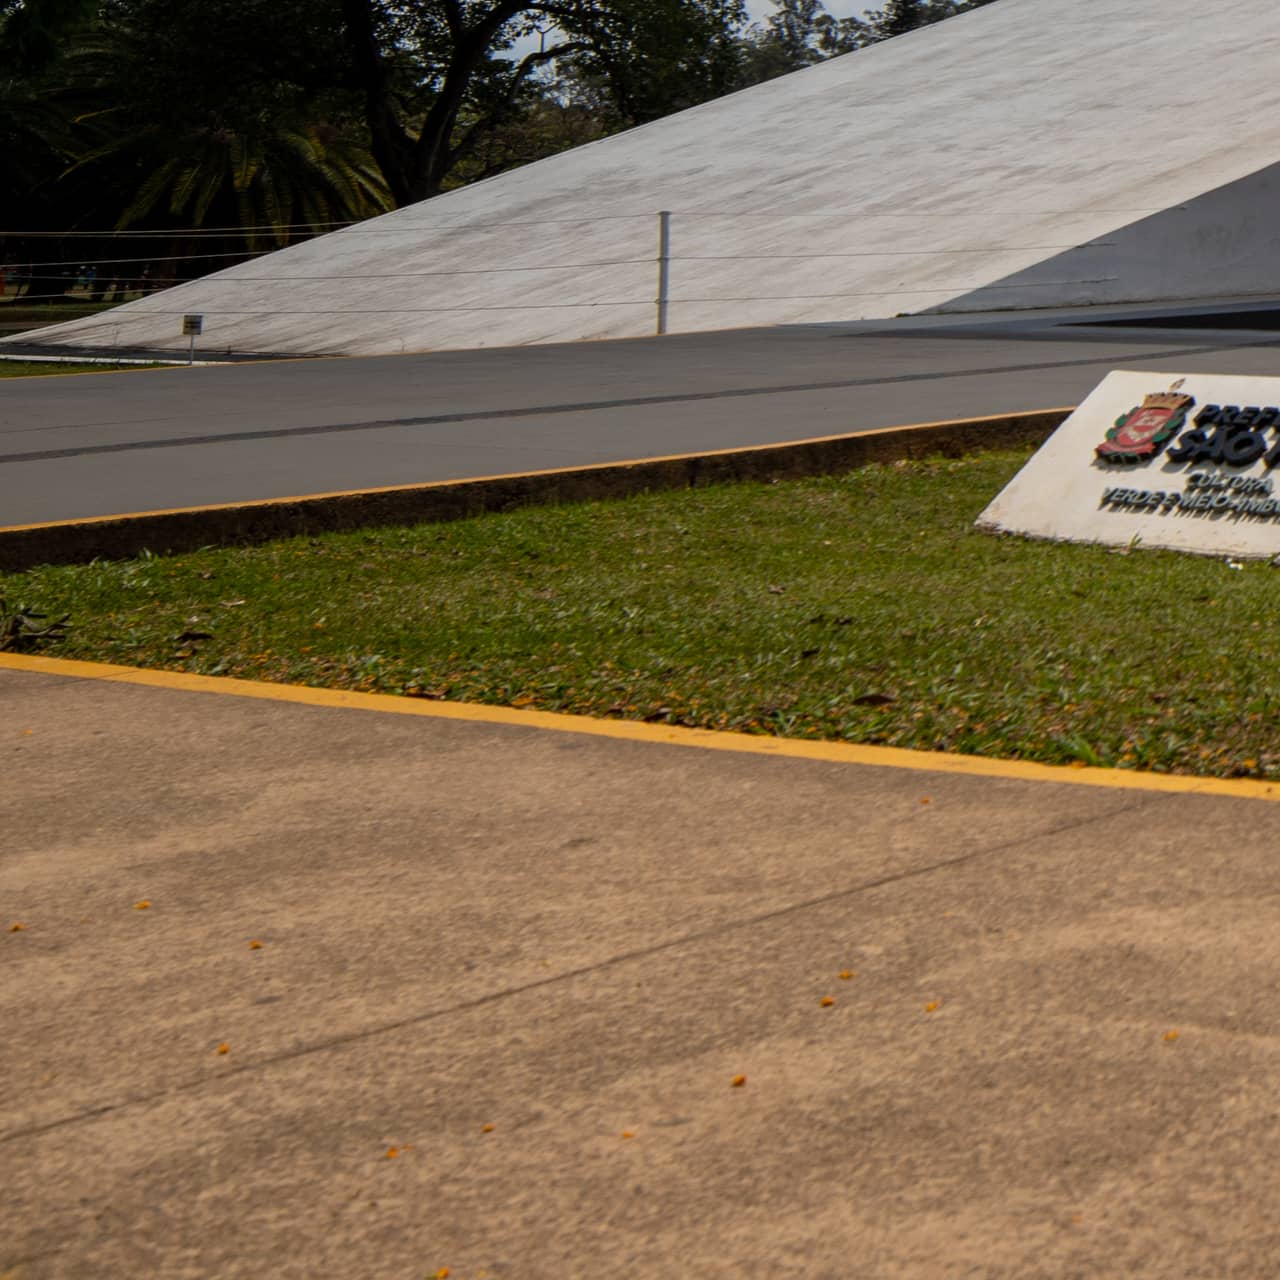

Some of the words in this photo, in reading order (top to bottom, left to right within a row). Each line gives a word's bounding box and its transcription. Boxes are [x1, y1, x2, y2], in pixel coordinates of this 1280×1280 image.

[1165, 423, 1268, 467] SÃO
[1186, 472, 1274, 495] CULTURA
[1100, 487, 1161, 507] VERDE
[1161, 492, 1180, 508] E
[1178, 492, 1231, 512] MEIO
